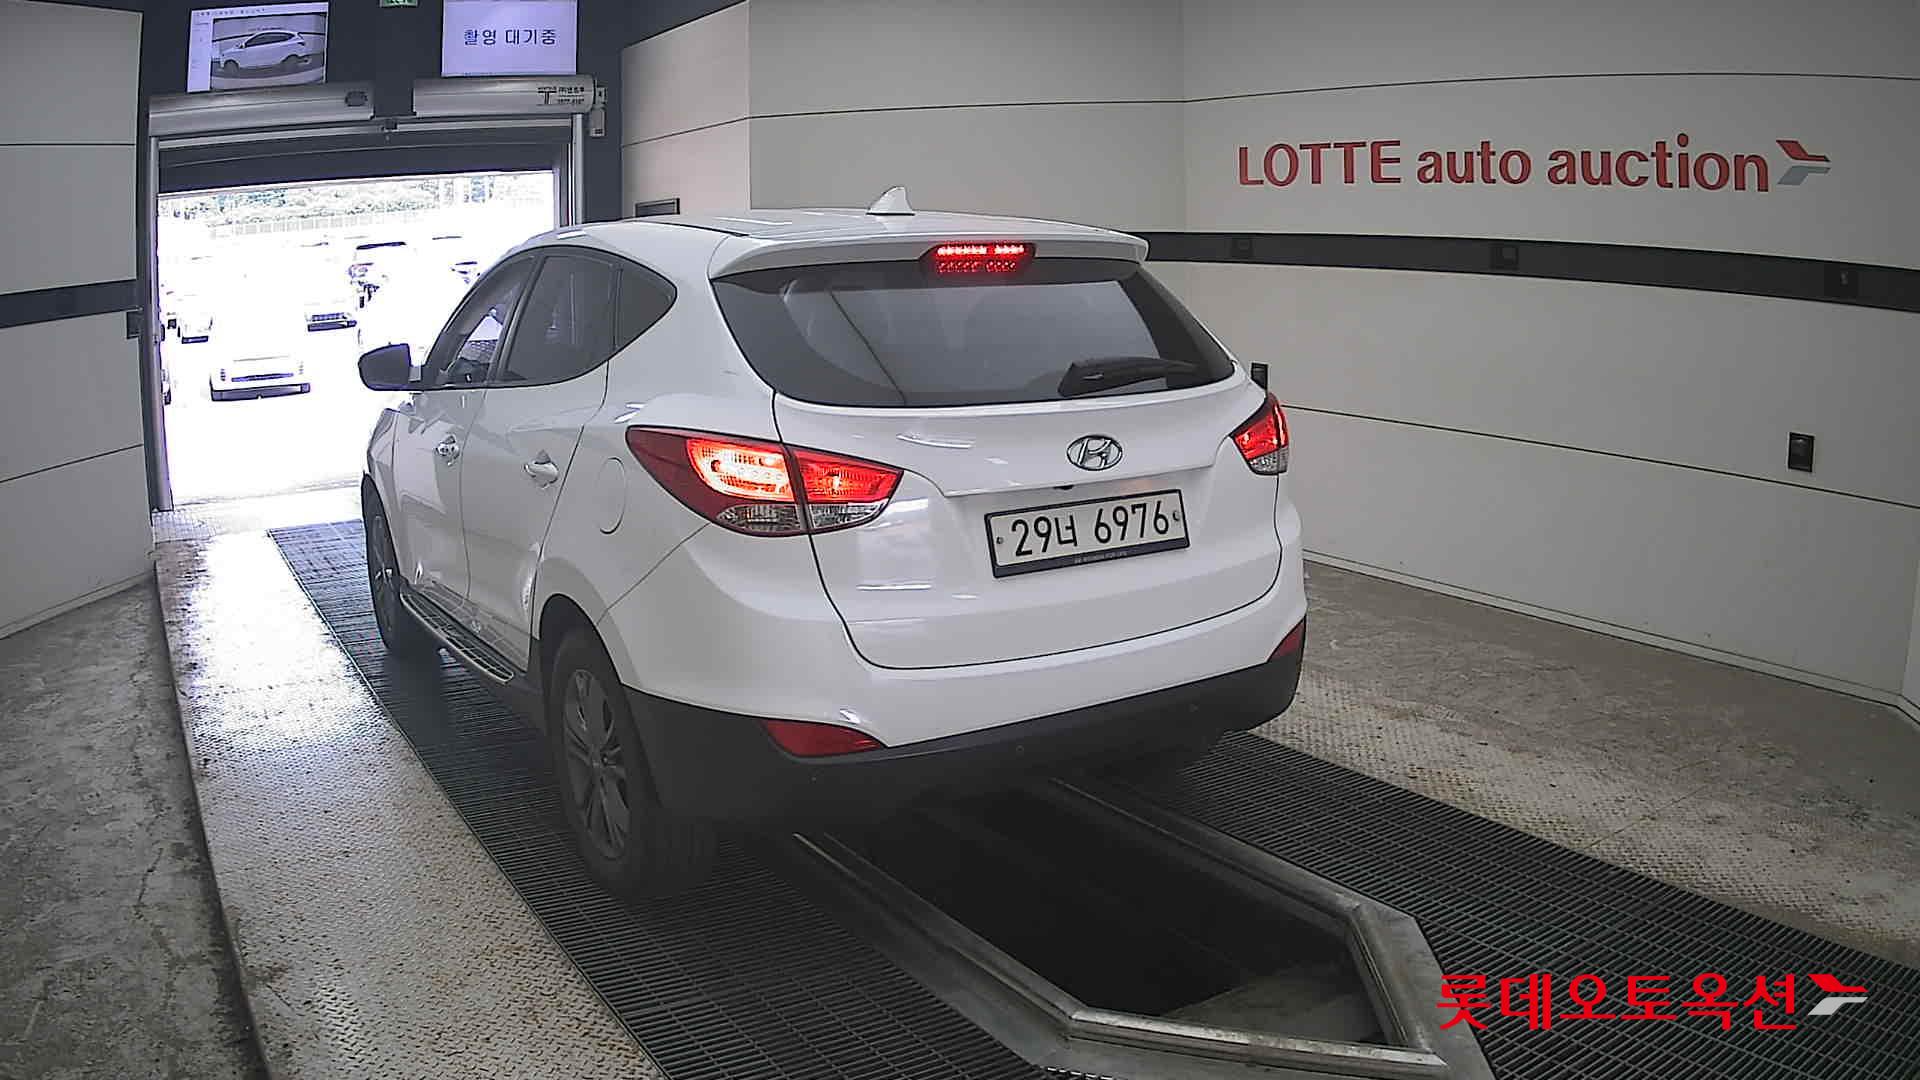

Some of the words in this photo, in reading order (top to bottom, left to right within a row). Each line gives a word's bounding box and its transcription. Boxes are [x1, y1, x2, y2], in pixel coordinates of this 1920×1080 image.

[505, 29, 557, 46] 대기중
[1238, 139, 1402, 187] LOTTE
[1416, 140, 1533, 186] auto
[1547, 132, 1770, 193] auction
[1011, 513, 1078, 557] 29너
[1094, 500, 1169, 544] 6976
